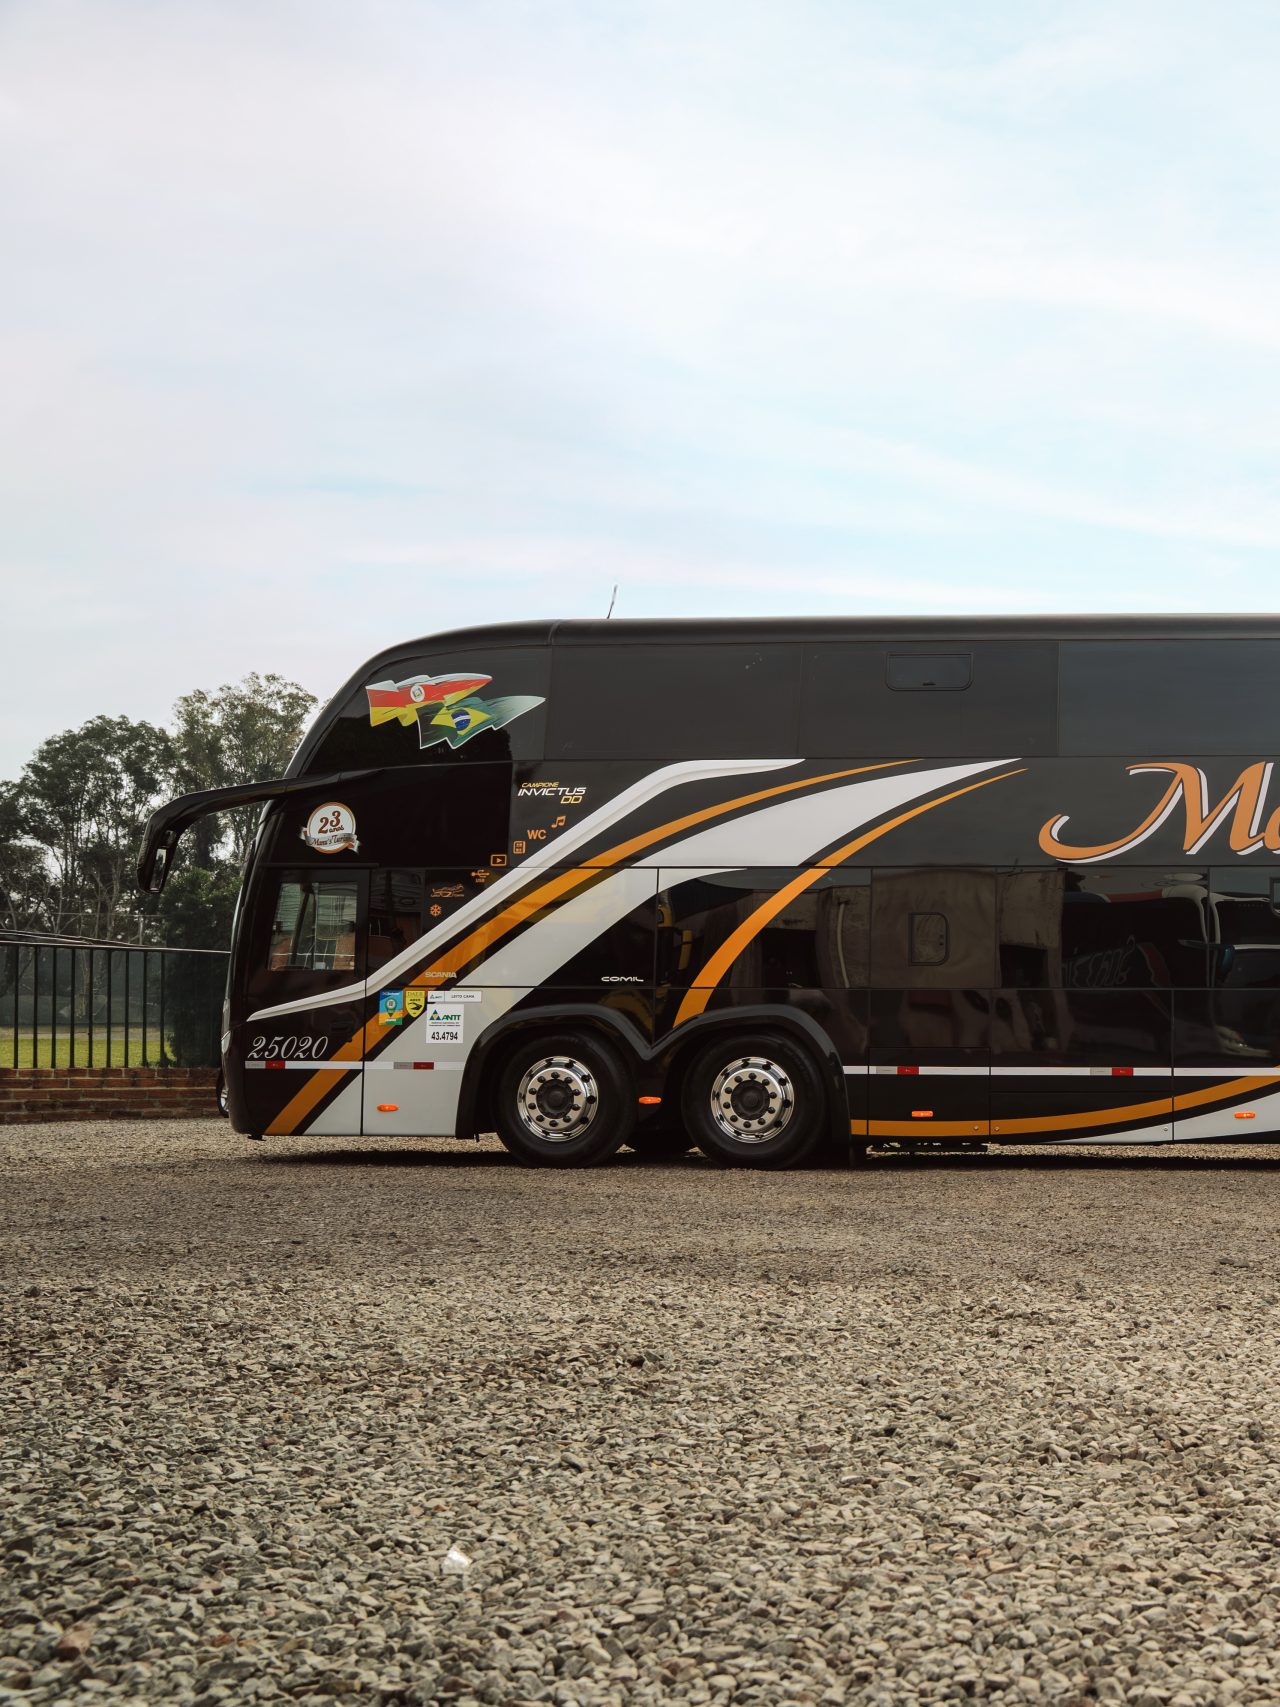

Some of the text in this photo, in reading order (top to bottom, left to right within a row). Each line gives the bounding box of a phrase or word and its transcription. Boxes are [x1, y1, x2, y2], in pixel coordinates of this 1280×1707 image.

[517, 787, 587, 797] INVICTUS
[560, 795, 583, 804] DD
[318, 810, 341, 834] 23
[527, 829, 547, 840] WC
[431, 1031, 458, 1041] 43.4794
[247, 1035, 329, 1059] 25020
